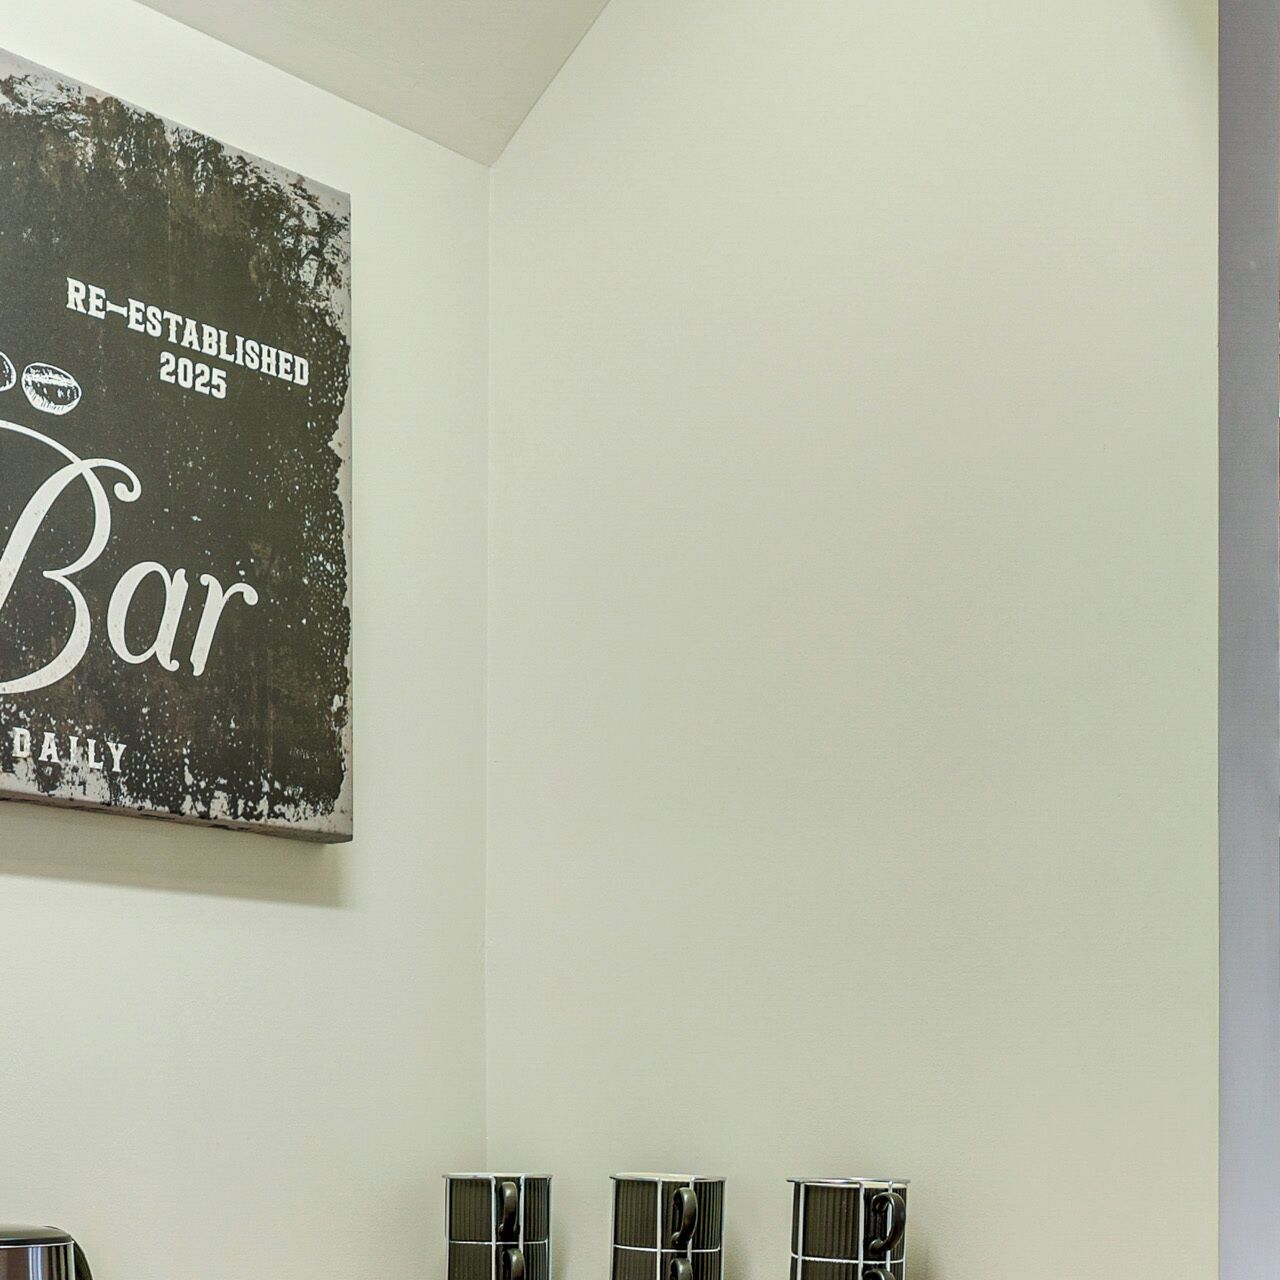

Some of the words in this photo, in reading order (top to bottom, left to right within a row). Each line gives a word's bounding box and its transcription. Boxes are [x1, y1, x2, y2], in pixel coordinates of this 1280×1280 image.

[66, 277, 310, 386] RE-ESTABLISHED
[160, 351, 227, 399] 2025
[12, 726, 127, 773] DAILY
